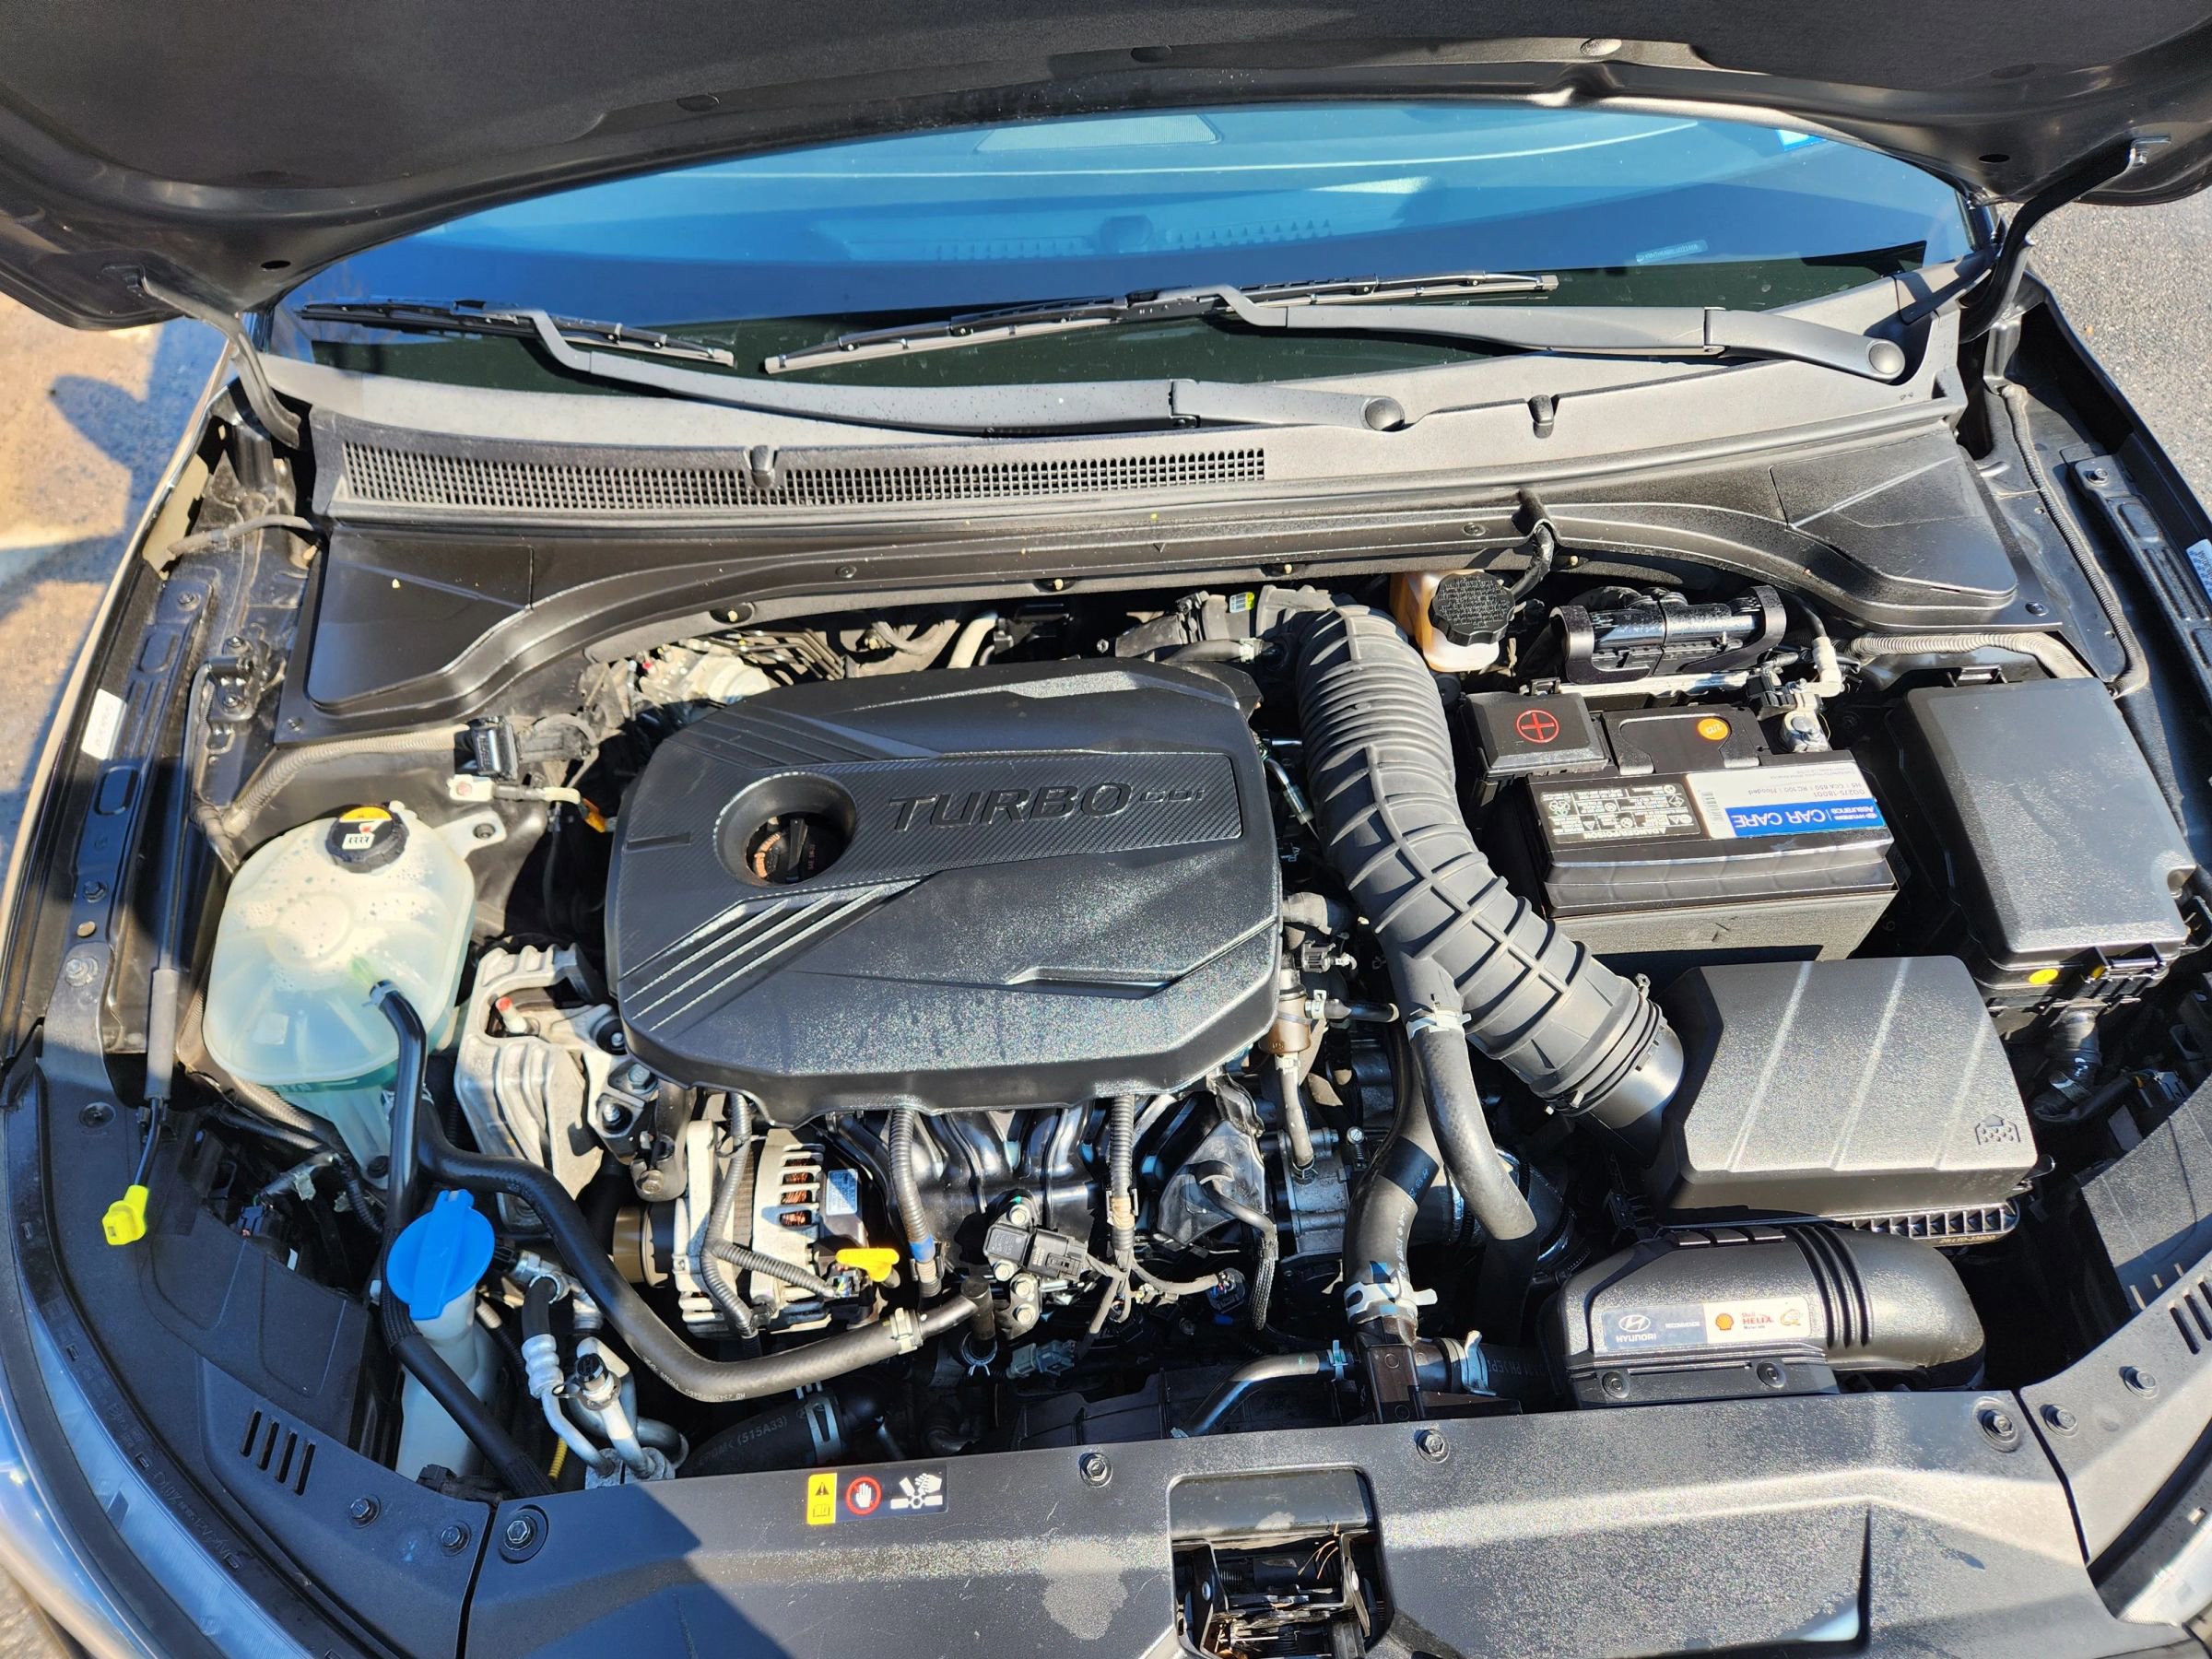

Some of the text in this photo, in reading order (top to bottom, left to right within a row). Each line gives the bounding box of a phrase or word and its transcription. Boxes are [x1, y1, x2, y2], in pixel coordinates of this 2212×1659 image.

[888, 782, 1134, 831] TURBO
[1731, 808, 1827, 829] CAR CARE
[1742, 1316, 1773, 1325] HELIX
[1615, 1334, 1657, 1343] HYUNDAI
[737, 1415, 788, 1445] (515A33)
